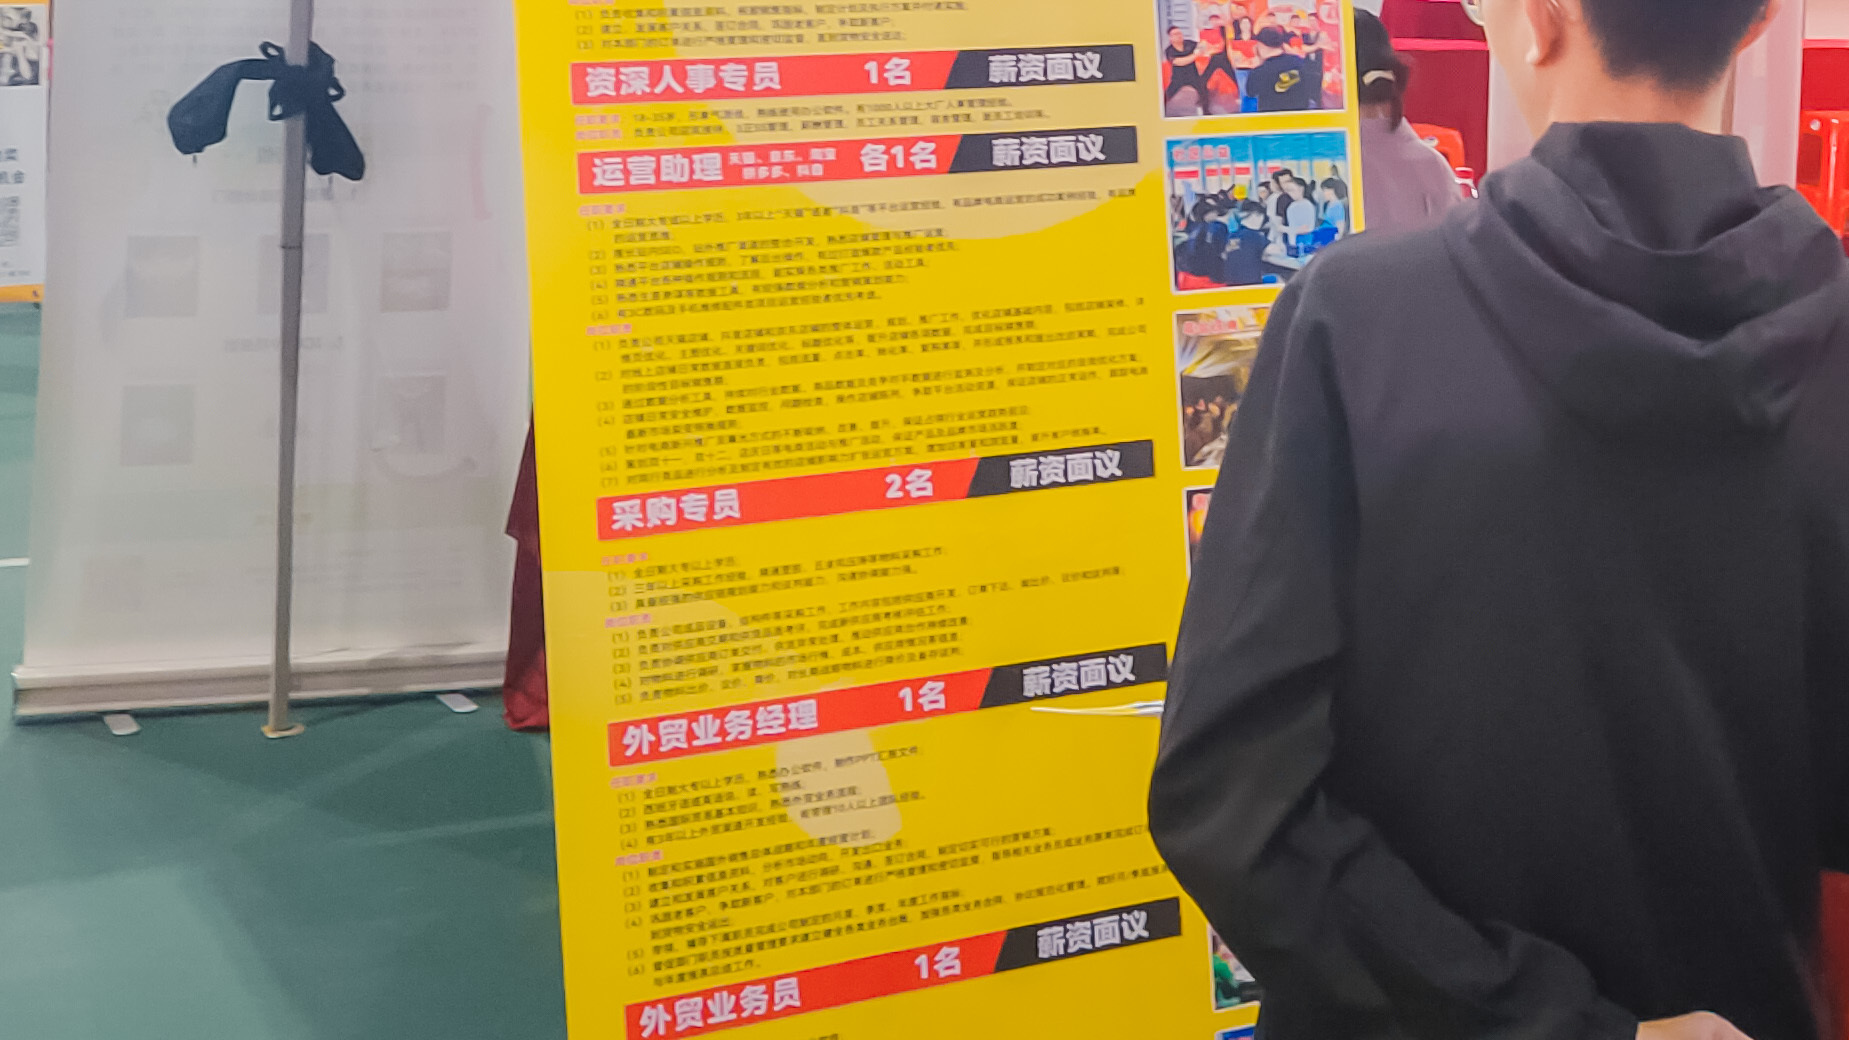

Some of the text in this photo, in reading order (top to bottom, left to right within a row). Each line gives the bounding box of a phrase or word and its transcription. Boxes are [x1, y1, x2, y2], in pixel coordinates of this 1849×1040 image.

[586, 51, 1104, 98] 资深人事专员 1名 薪资面议
[592, 152, 724, 187] 运营助理
[859, 141, 938, 173] 各1名
[991, 134, 1106, 168] 薪资面议
[611, 448, 1124, 532] 采购专员 2名 薪资面议
[622, 652, 1136, 758] 外贸业务经理 1名 薪资面议
[639, 977, 803, 1040] 外贸业务员
[914, 945, 962, 980] 1名
[1036, 909, 1151, 960] 薪资面议
